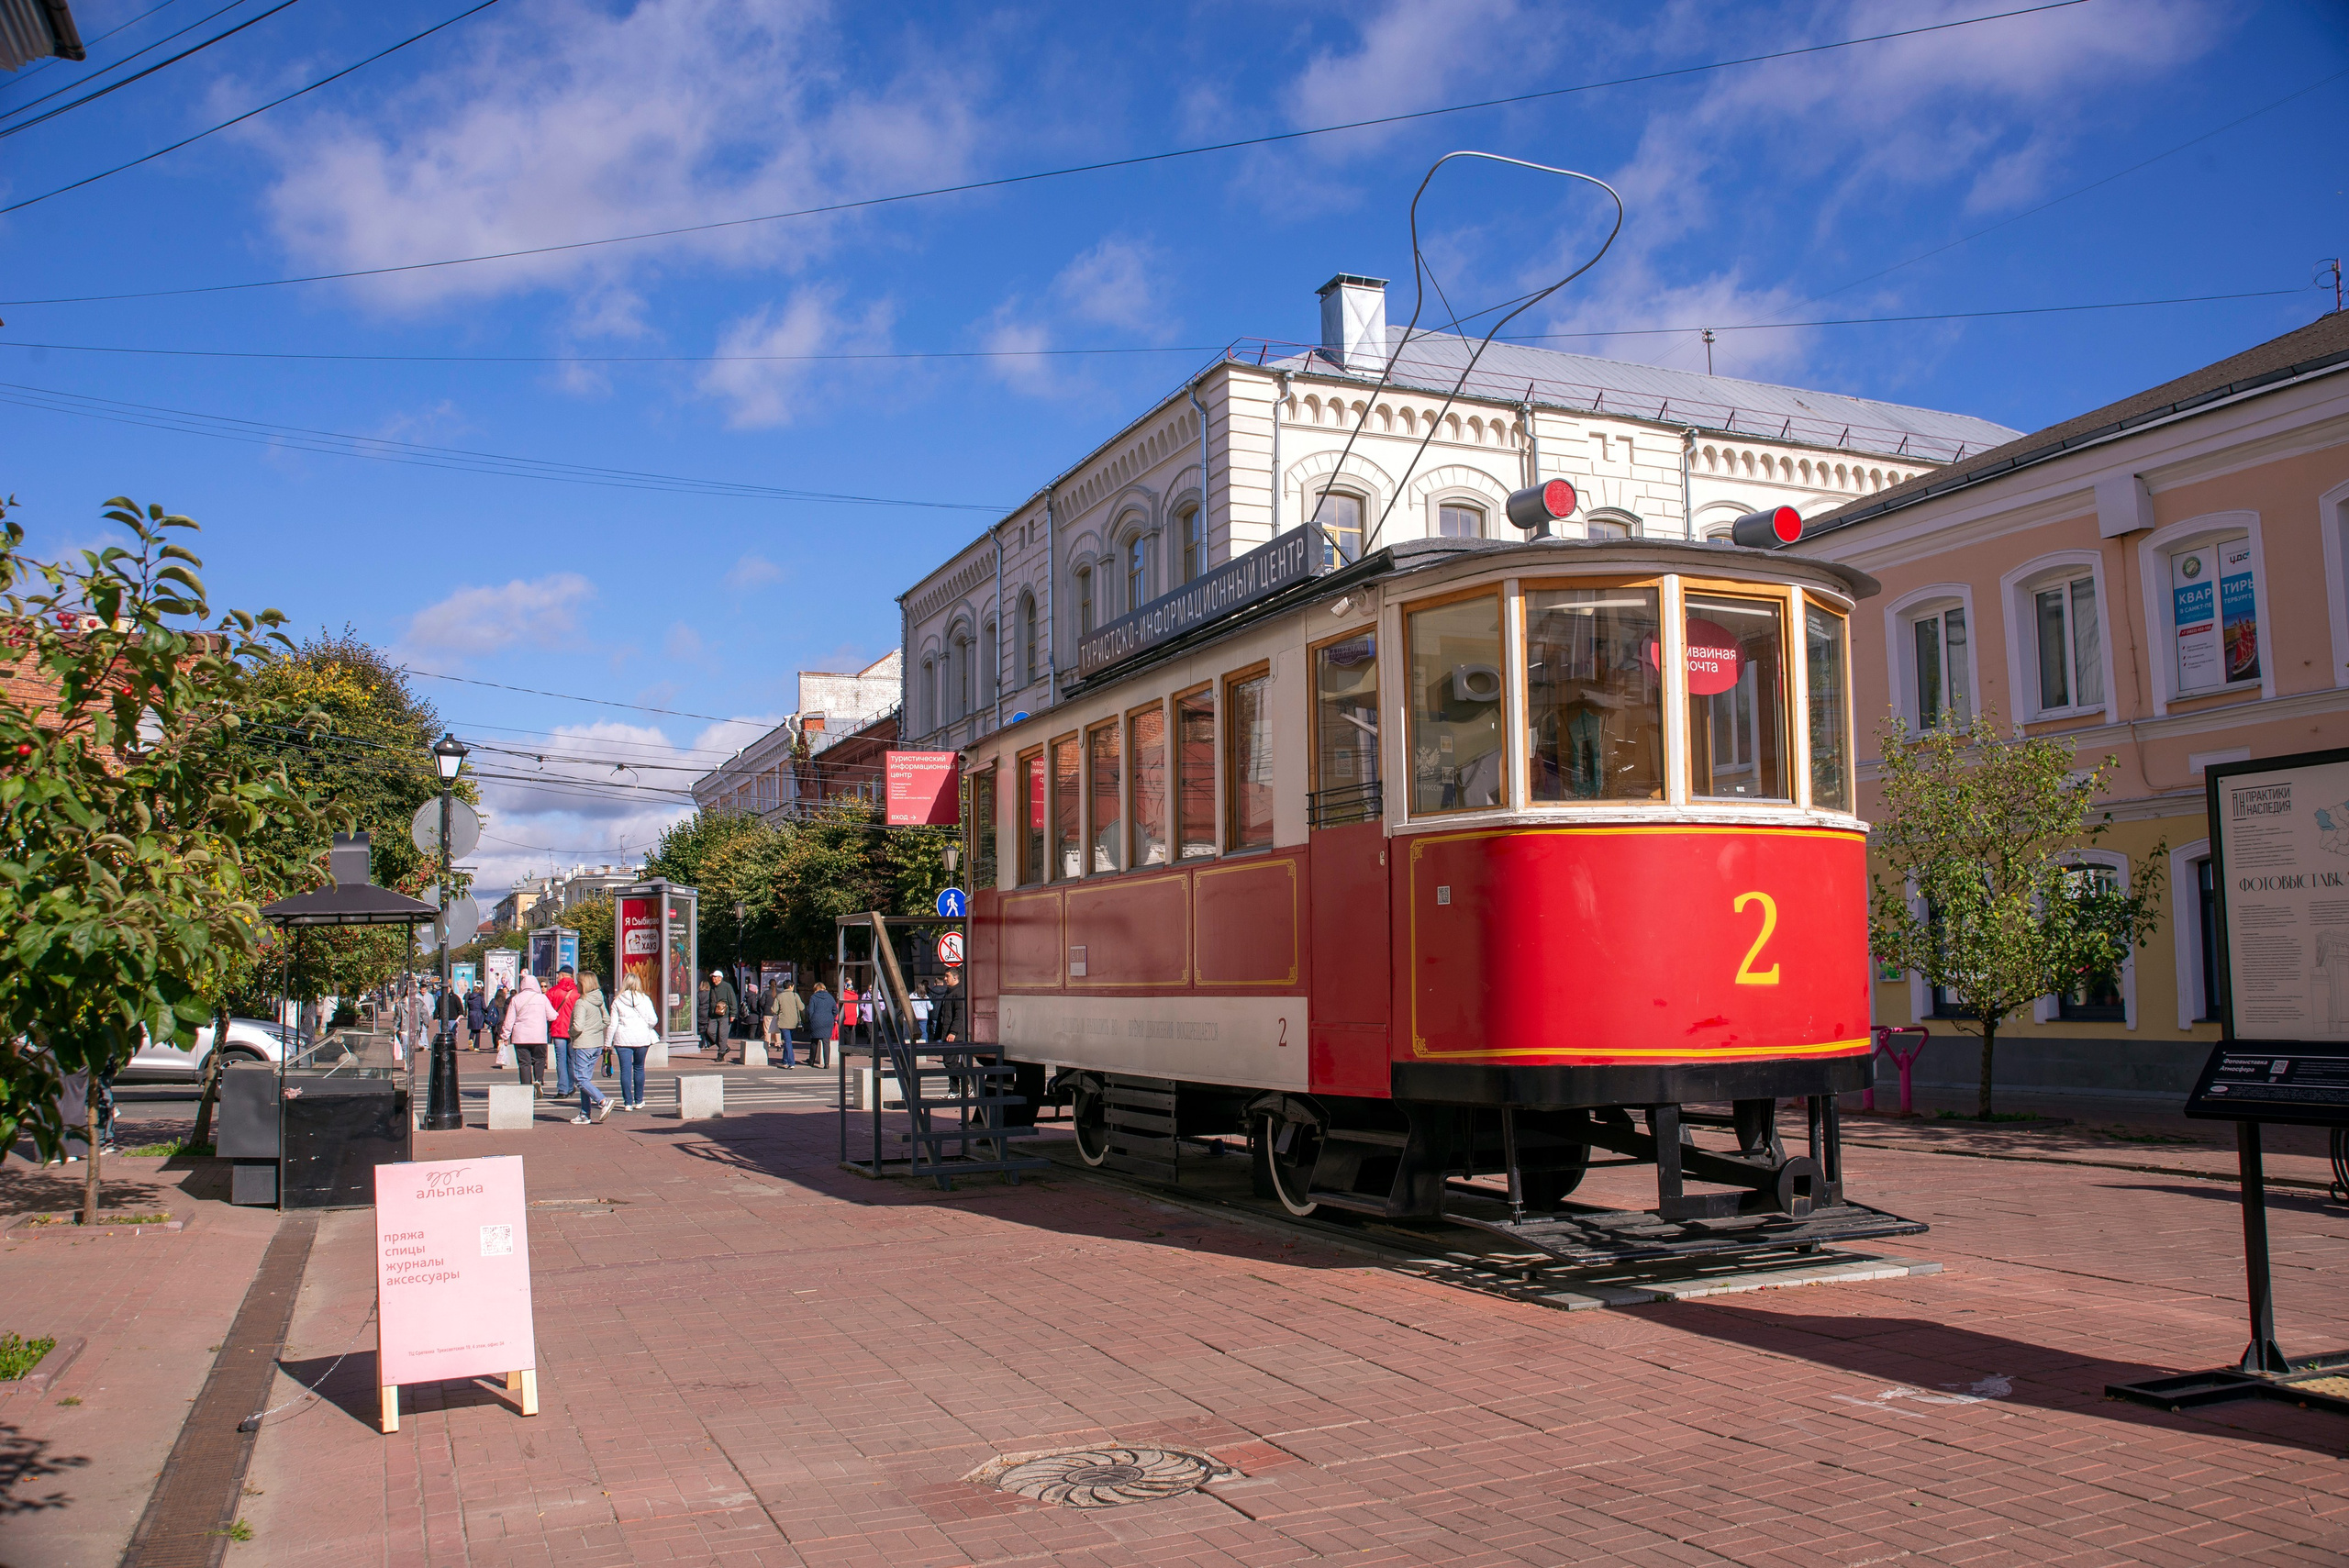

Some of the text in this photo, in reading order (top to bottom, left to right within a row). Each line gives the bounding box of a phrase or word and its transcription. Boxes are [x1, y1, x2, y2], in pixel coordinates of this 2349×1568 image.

[1081, 537, 1305, 671] ТУРИСТСКО-ИНФОРМАЦИОННЫЙ ЦЕНТР
[1687, 645, 1736, 660] мвайная
[1687, 661, 1719, 673] очта
[2246, 787, 2290, 803] ПРАКТИКИ
[2246, 800, 2291, 816] НАСЛЕДИЯ
[2239, 872, 2349, 892] ФОТОВЫСТАВК
[625, 917, 630, 926] Я
[1733, 891, 1780, 984] 2
[641, 942, 657, 951] ХАУЗ
[1007, 1007, 1012, 1029] 2
[1278, 1017, 1287, 1047] 2
[417, 1184, 484, 1199] альпака
[384, 1230, 424, 1244] пряжа
[384, 1245, 425, 1256] спицы
[386, 1258, 444, 1273] журналы
[386, 1271, 460, 1286] аксессуары
